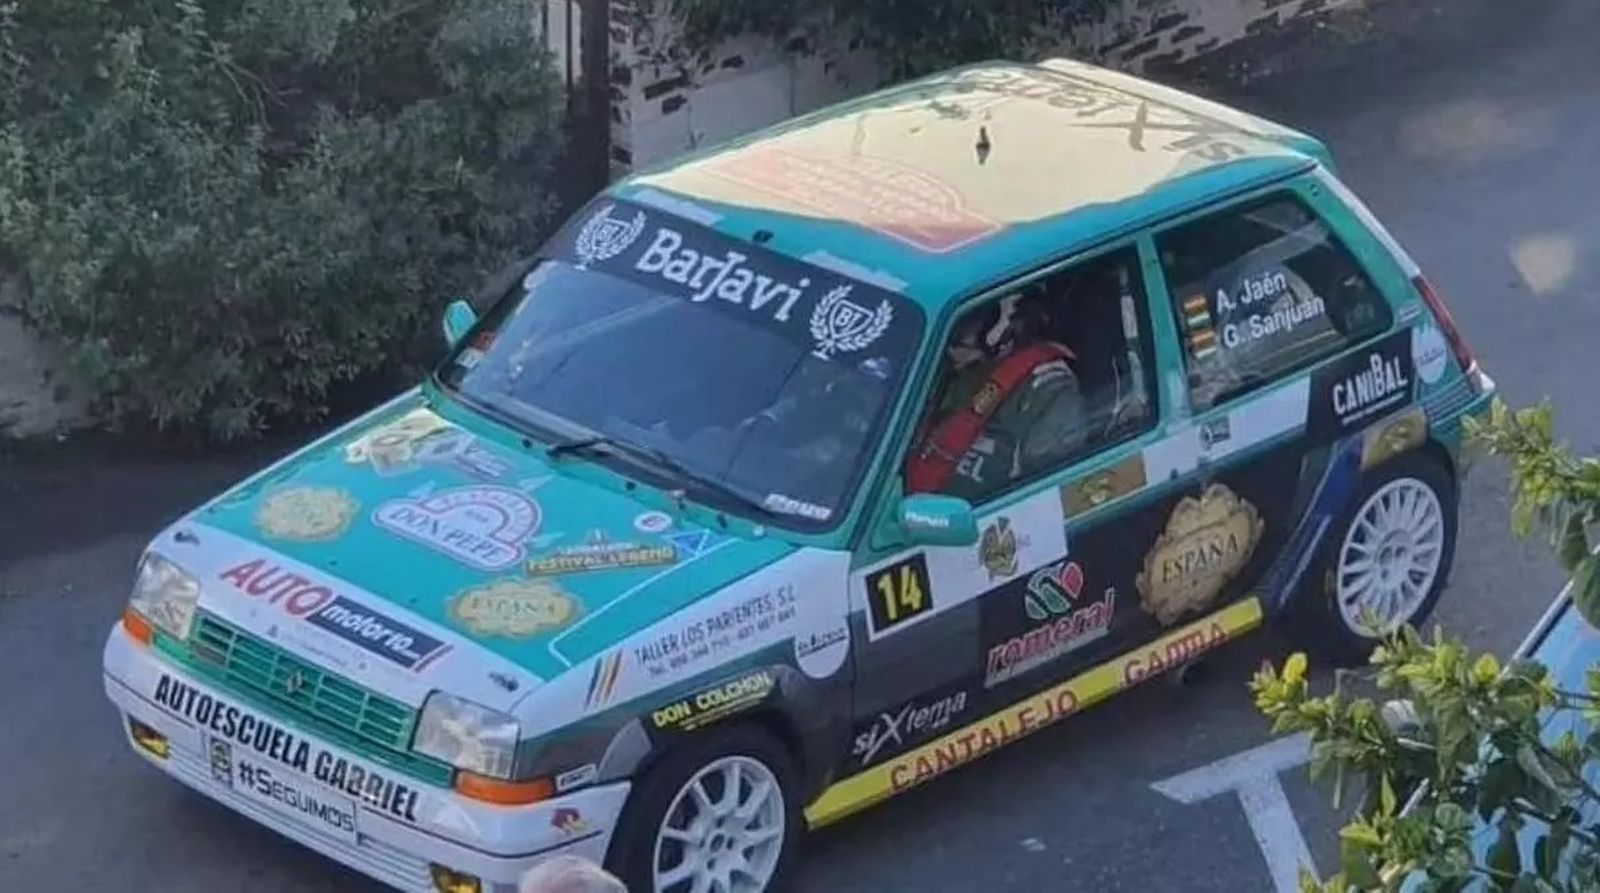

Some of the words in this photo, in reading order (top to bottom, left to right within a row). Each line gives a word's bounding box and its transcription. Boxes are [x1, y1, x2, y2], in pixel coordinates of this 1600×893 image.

[634, 227, 811, 323] BarJavi
[1332, 353, 1409, 415] CANIBAL
[389, 507, 441, 536] DON
[443, 526, 502, 564] PEPE
[219, 558, 334, 617] AUTO
[877, 563, 924, 622] 14
[681, 622, 705, 645] LOS
[653, 700, 692, 728] DON
[889, 688, 1080, 791] CANTALEJO
[153, 673, 310, 773] AUTOESCUELA
[314, 750, 420, 823] GABRIEL
